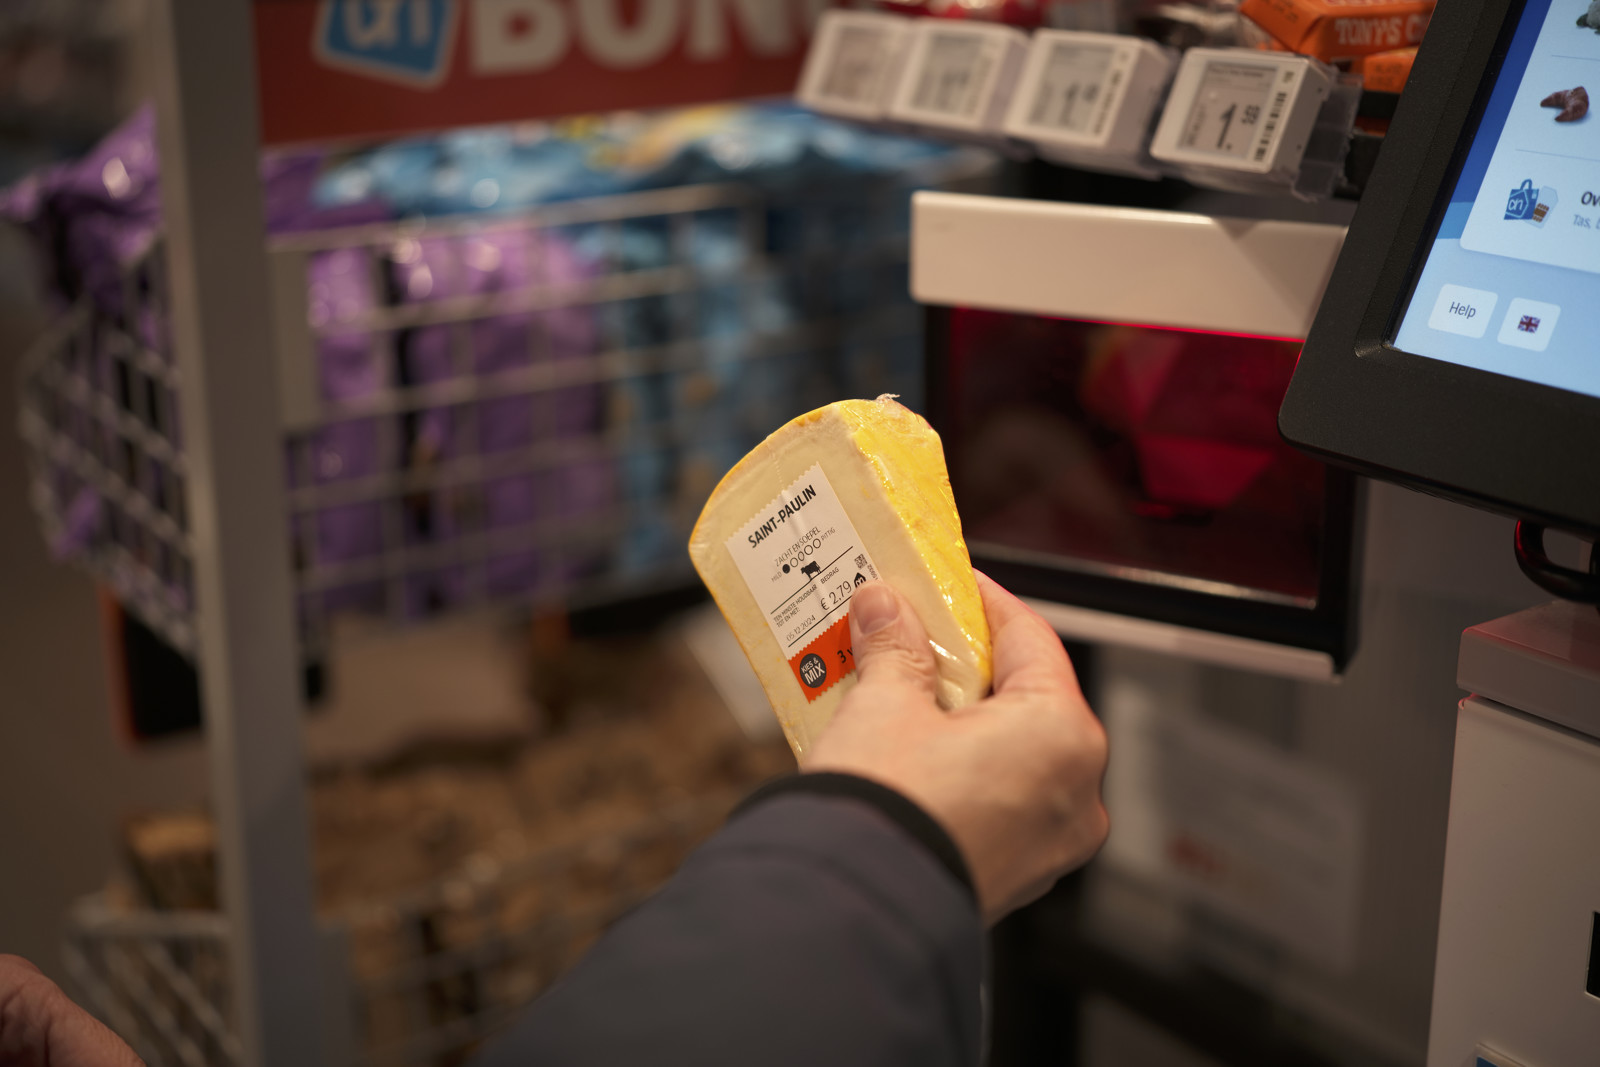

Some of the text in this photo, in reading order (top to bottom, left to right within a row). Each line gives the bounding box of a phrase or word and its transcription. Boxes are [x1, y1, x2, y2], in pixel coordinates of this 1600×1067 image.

[1449, 301, 1476, 319] Help
[748, 485, 817, 549] SAINT-PAULIN
[774, 548, 793, 567] ZACHT
[799, 526, 821, 546] SOEPEL
[820, 566, 840, 584] BEDRAG
[820, 580, 852, 610] € 2,79
[801, 660, 814, 673] KIES
[837, 650, 847, 664] 3
[804, 662, 825, 685] MIX
